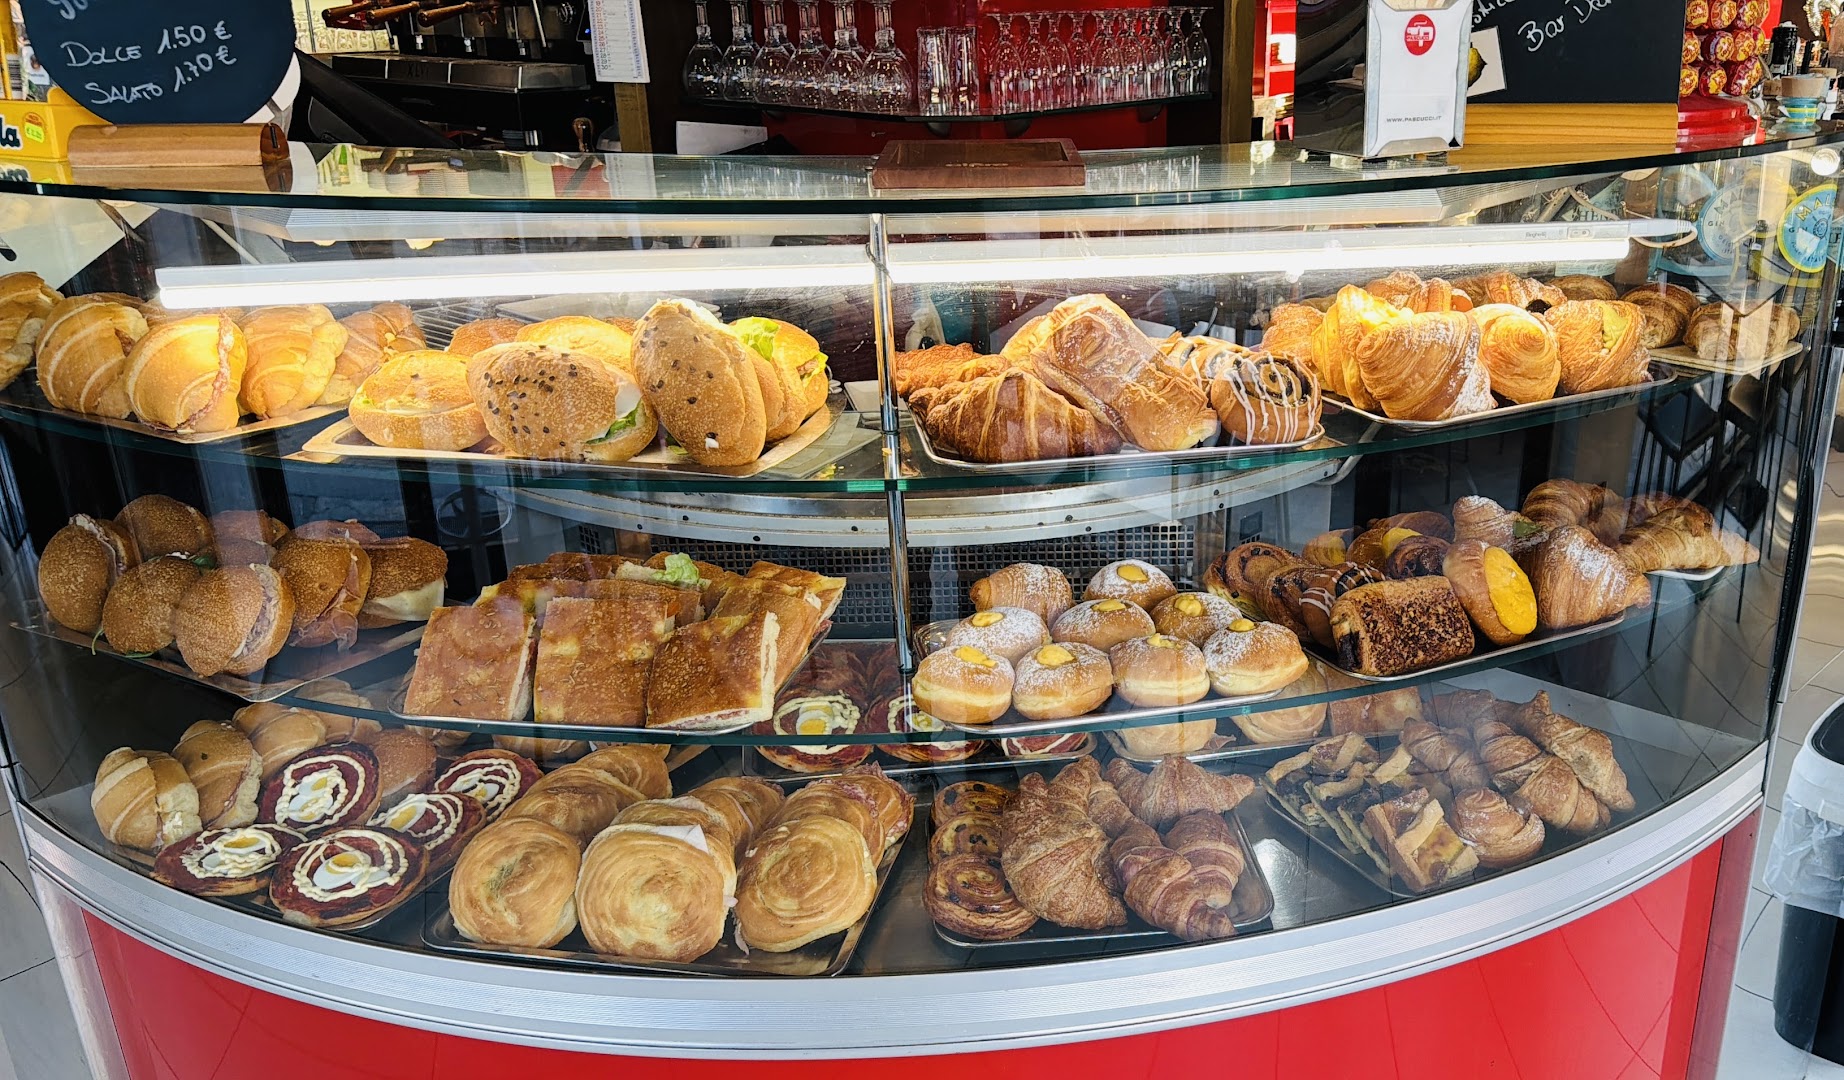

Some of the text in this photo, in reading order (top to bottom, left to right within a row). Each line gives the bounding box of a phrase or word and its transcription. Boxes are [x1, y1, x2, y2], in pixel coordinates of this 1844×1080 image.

[60, 20, 232, 67] DOLCE 1.50 €
[1517, 15, 1565, 52] Bar
[85, 45, 237, 104] SALATO 1.70 €
